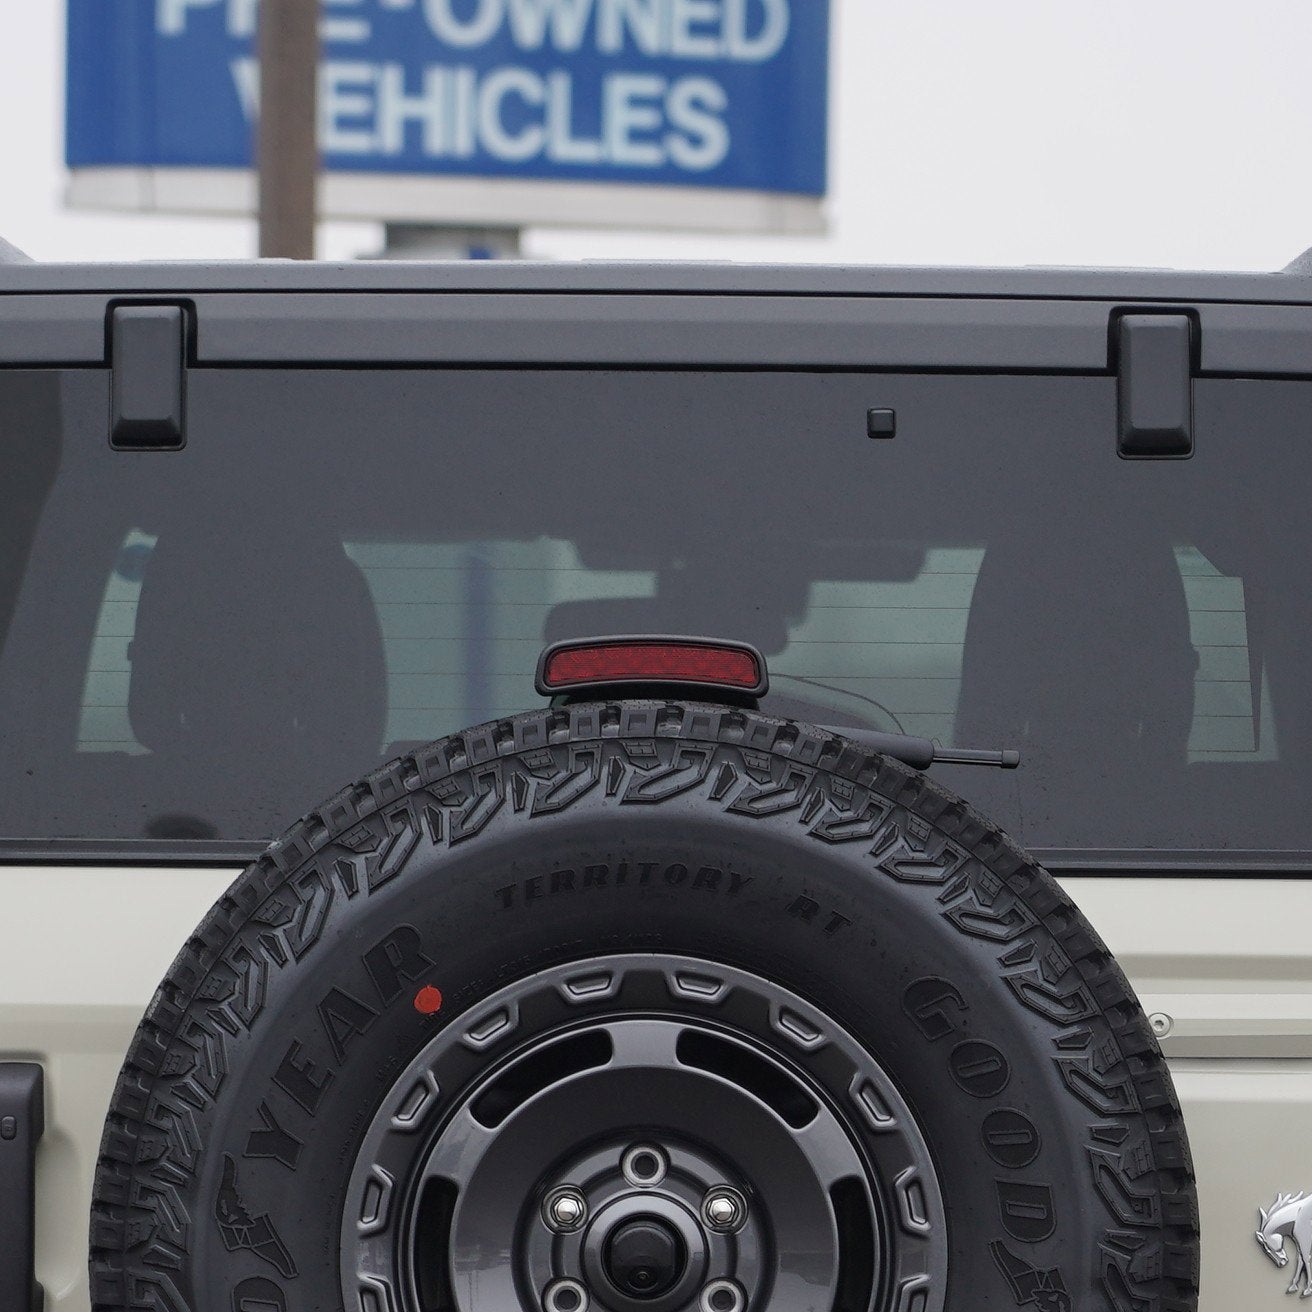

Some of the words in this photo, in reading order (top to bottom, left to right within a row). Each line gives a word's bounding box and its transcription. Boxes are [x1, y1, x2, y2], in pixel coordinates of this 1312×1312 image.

[155, 0, 790, 62] -OWNED
[493, 861, 752, 911] TERRITORY
[786, 893, 853, 938] RT
